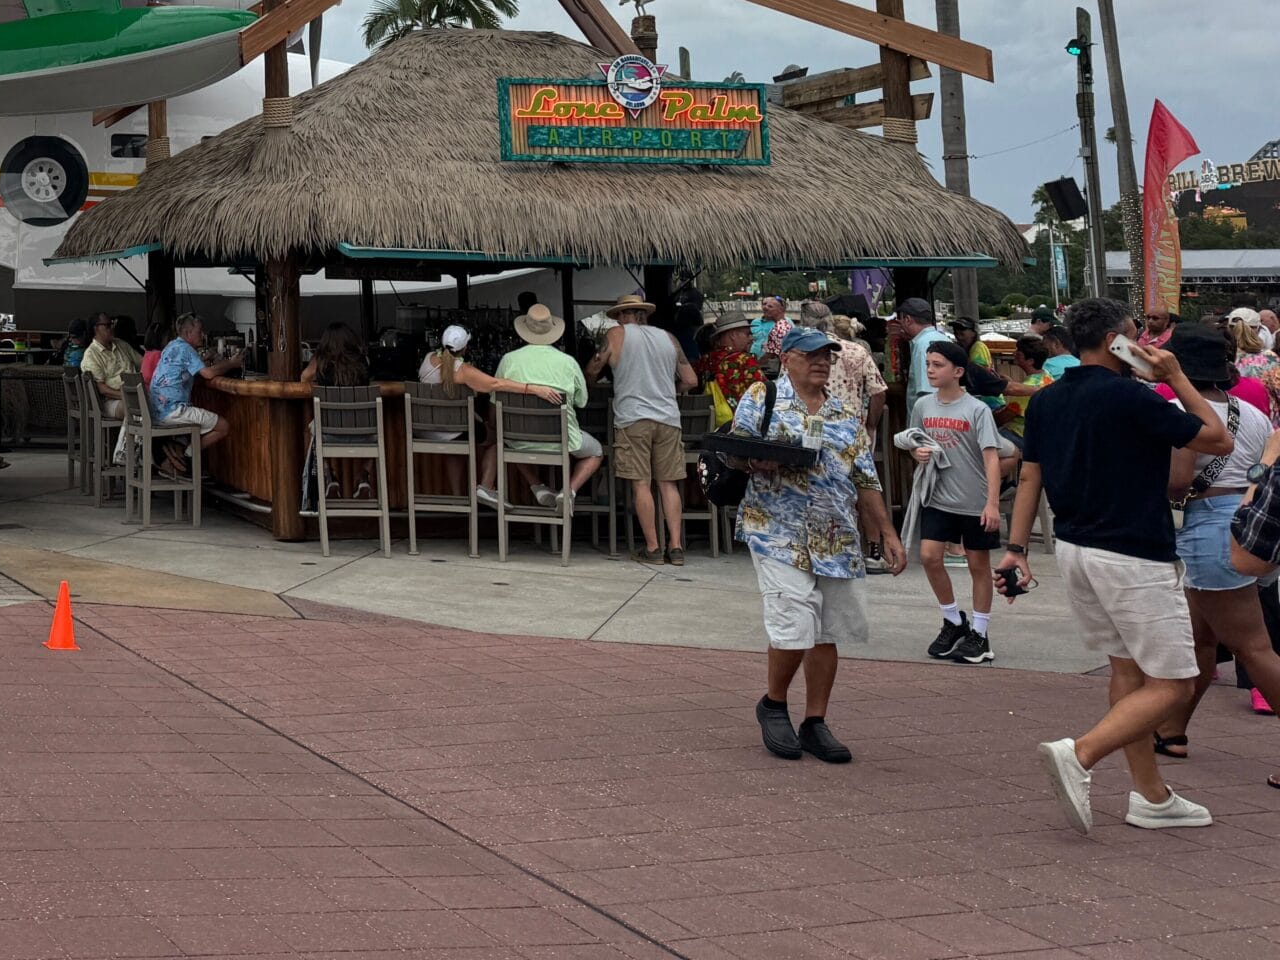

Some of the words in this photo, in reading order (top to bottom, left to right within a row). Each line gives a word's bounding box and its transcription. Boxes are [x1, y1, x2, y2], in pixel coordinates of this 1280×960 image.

[517, 88, 624, 119] Lone
[660, 90, 763, 122] Palm
[548, 127, 728, 148] AIRPORT
